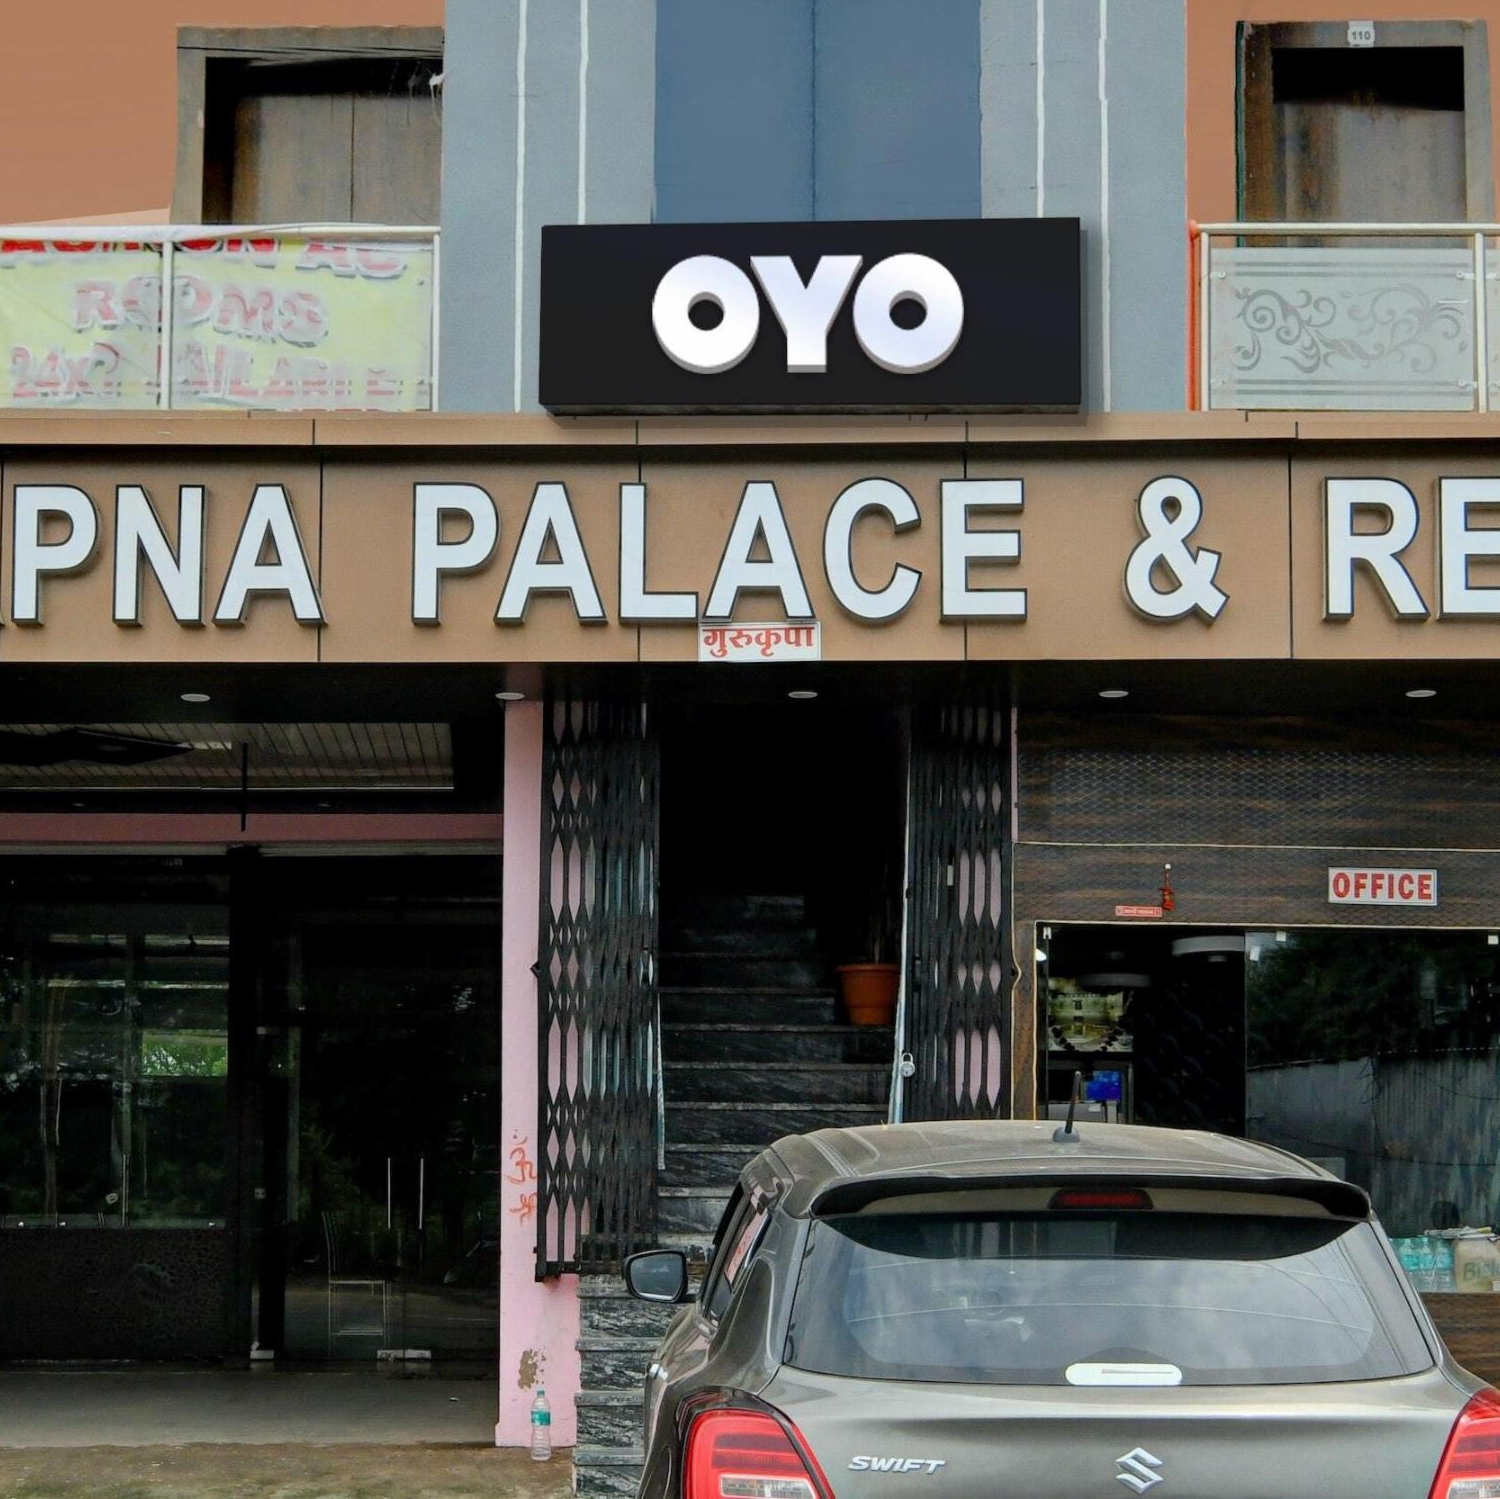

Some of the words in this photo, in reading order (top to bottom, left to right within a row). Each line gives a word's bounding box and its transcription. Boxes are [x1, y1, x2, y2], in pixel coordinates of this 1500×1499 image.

[1351, 30, 1371, 41] 110
[652, 252, 964, 374] OYO
[411, 476, 1029, 626] PALACE
[1123, 474, 1231, 627] &
[703, 627, 814, 657] गुरुकृपा
[1332, 871, 1432, 900] OFFICE
[847, 1455, 946, 1474] SWIFT
